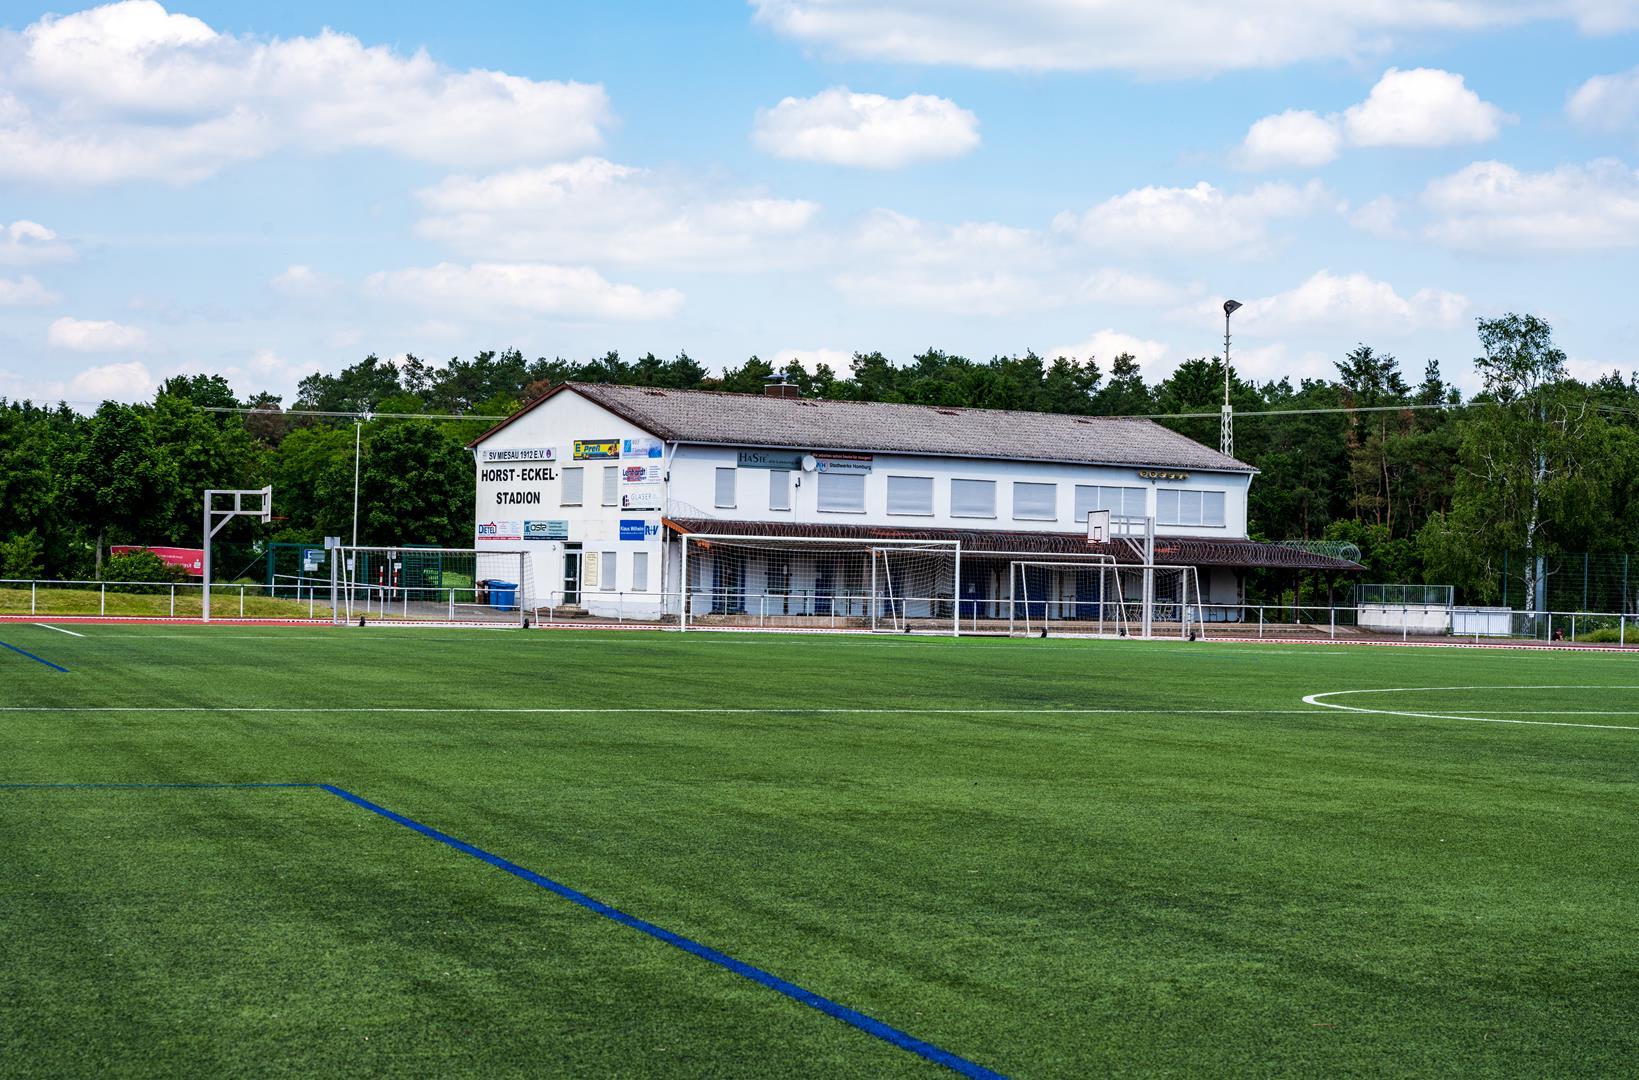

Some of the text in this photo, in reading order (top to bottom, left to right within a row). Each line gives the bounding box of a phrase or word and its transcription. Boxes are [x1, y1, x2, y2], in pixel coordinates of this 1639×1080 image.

[488, 450, 545, 460] SV MIESAU 1912 E.V.
[853, 463, 872, 471] Homburg
[496, 492, 540, 504] STADION
